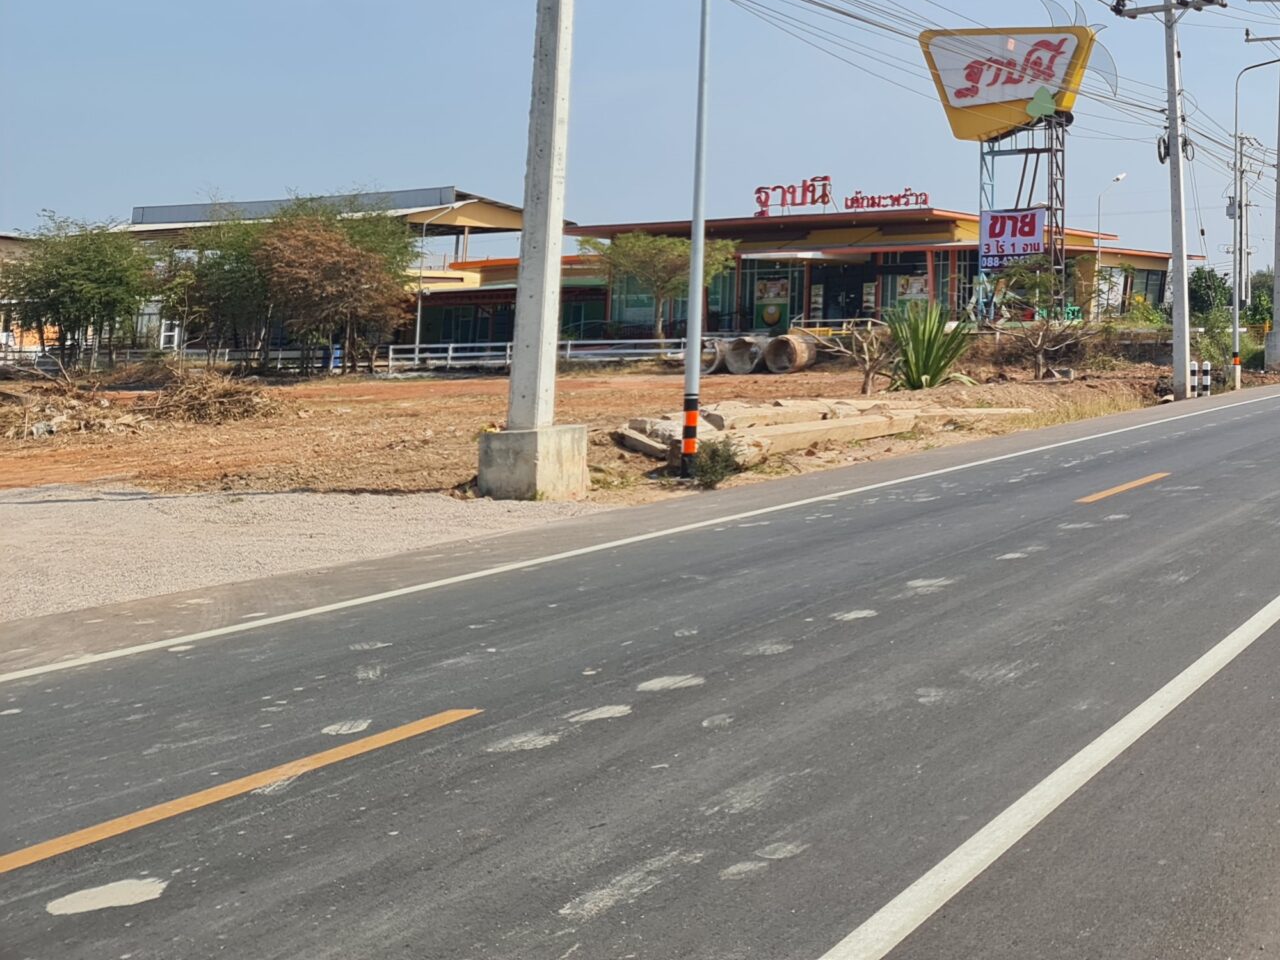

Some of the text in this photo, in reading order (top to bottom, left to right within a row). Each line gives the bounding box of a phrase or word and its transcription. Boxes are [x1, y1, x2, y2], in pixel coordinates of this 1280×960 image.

[754, 175, 930, 217] ฐาปนี เค้กมะพร้าว
[988, 213, 1036, 239] ขาย
[983, 240, 1041, 254] 3 ไร่ 1 งาน
